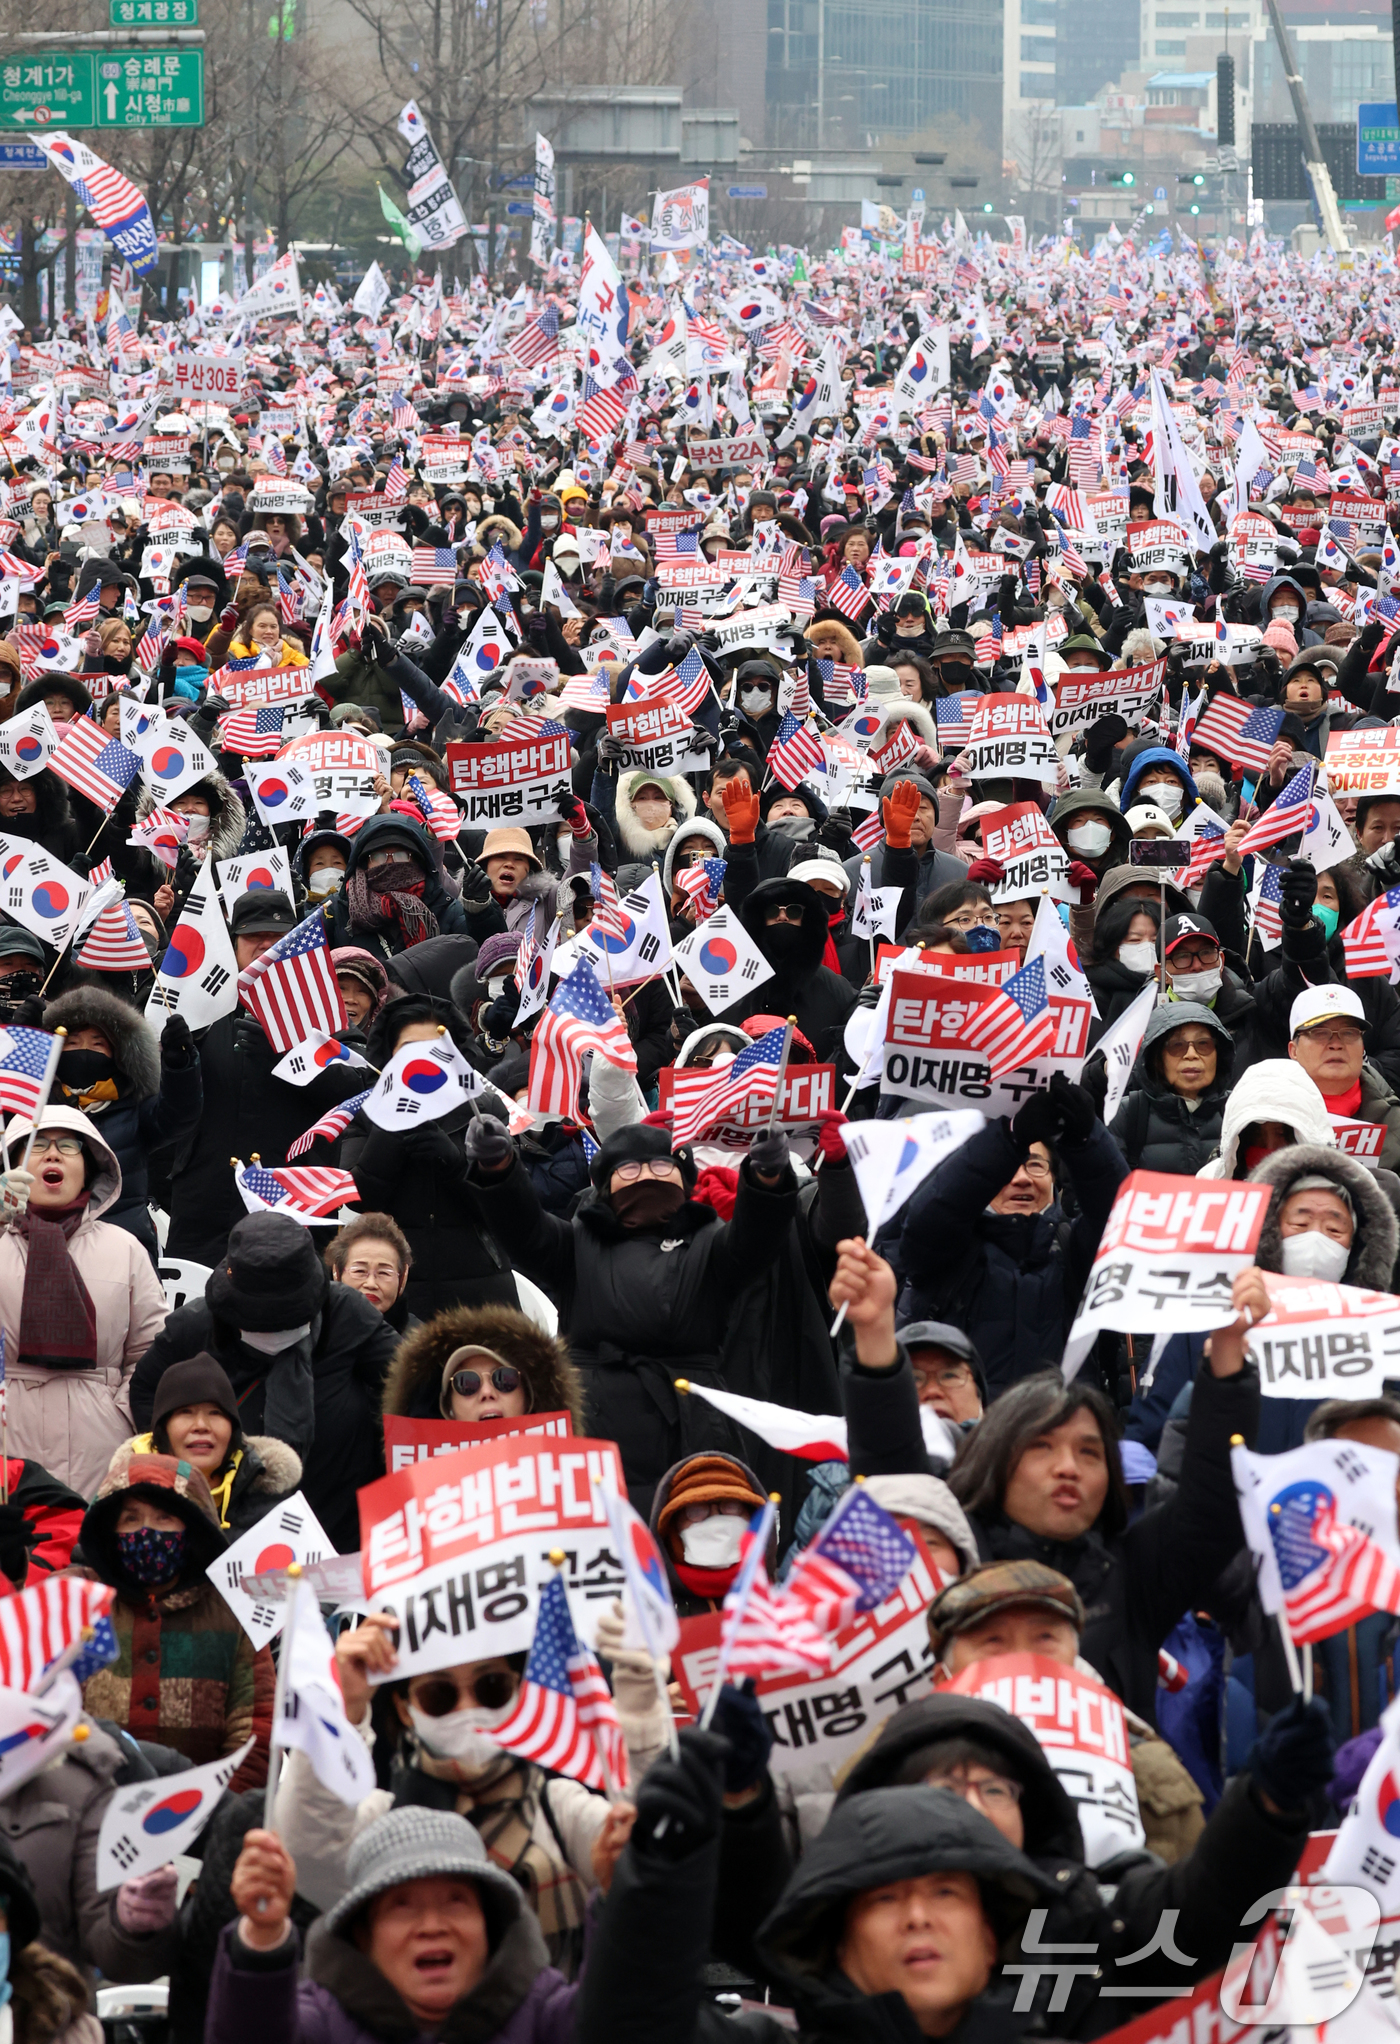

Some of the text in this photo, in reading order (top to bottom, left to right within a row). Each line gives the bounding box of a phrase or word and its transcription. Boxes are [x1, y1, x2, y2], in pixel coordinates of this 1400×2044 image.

[119, 2, 188, 21] 청계광장
[3, 65, 75, 87] 청계1가
[105, 65, 117, 76] 60
[123, 57, 182, 76] 숭례문
[124, 95, 161, 113] 시청
[125, 113, 171, 125] City Hall
[1343, 408, 1384, 425] 탄핵반대
[144, 437, 190, 454] 탄핵반대
[1278, 437, 1323, 450] 탄핵반대
[690, 443, 766, 466] 부산 22A
[1088, 499, 1130, 519] 핵반대
[1332, 502, 1386, 519] 탄핵반대
[647, 512, 703, 533] 탄핵반대
[657, 566, 731, 585] 탄핵반대
[656, 588, 700, 607] 이재명
[220, 669, 314, 704] 탄핵반대
[1059, 662, 1163, 709] 탄핵반대
[1055, 685, 1160, 733] 이재명 구속
[1340, 730, 1388, 749] 탄핵
[452, 737, 569, 789] 탄핵반대
[969, 741, 1027, 771] 이재명
[1336, 772, 1390, 792] 이재명
[461, 789, 524, 823] 이재명
[886, 1053, 993, 1099] 이재명
[1138, 1269, 1237, 1312] 구속
[369, 1450, 619, 1589] 탄핵반대
[378, 1555, 530, 1655] 이재명
[765, 1683, 868, 1750] 재명
